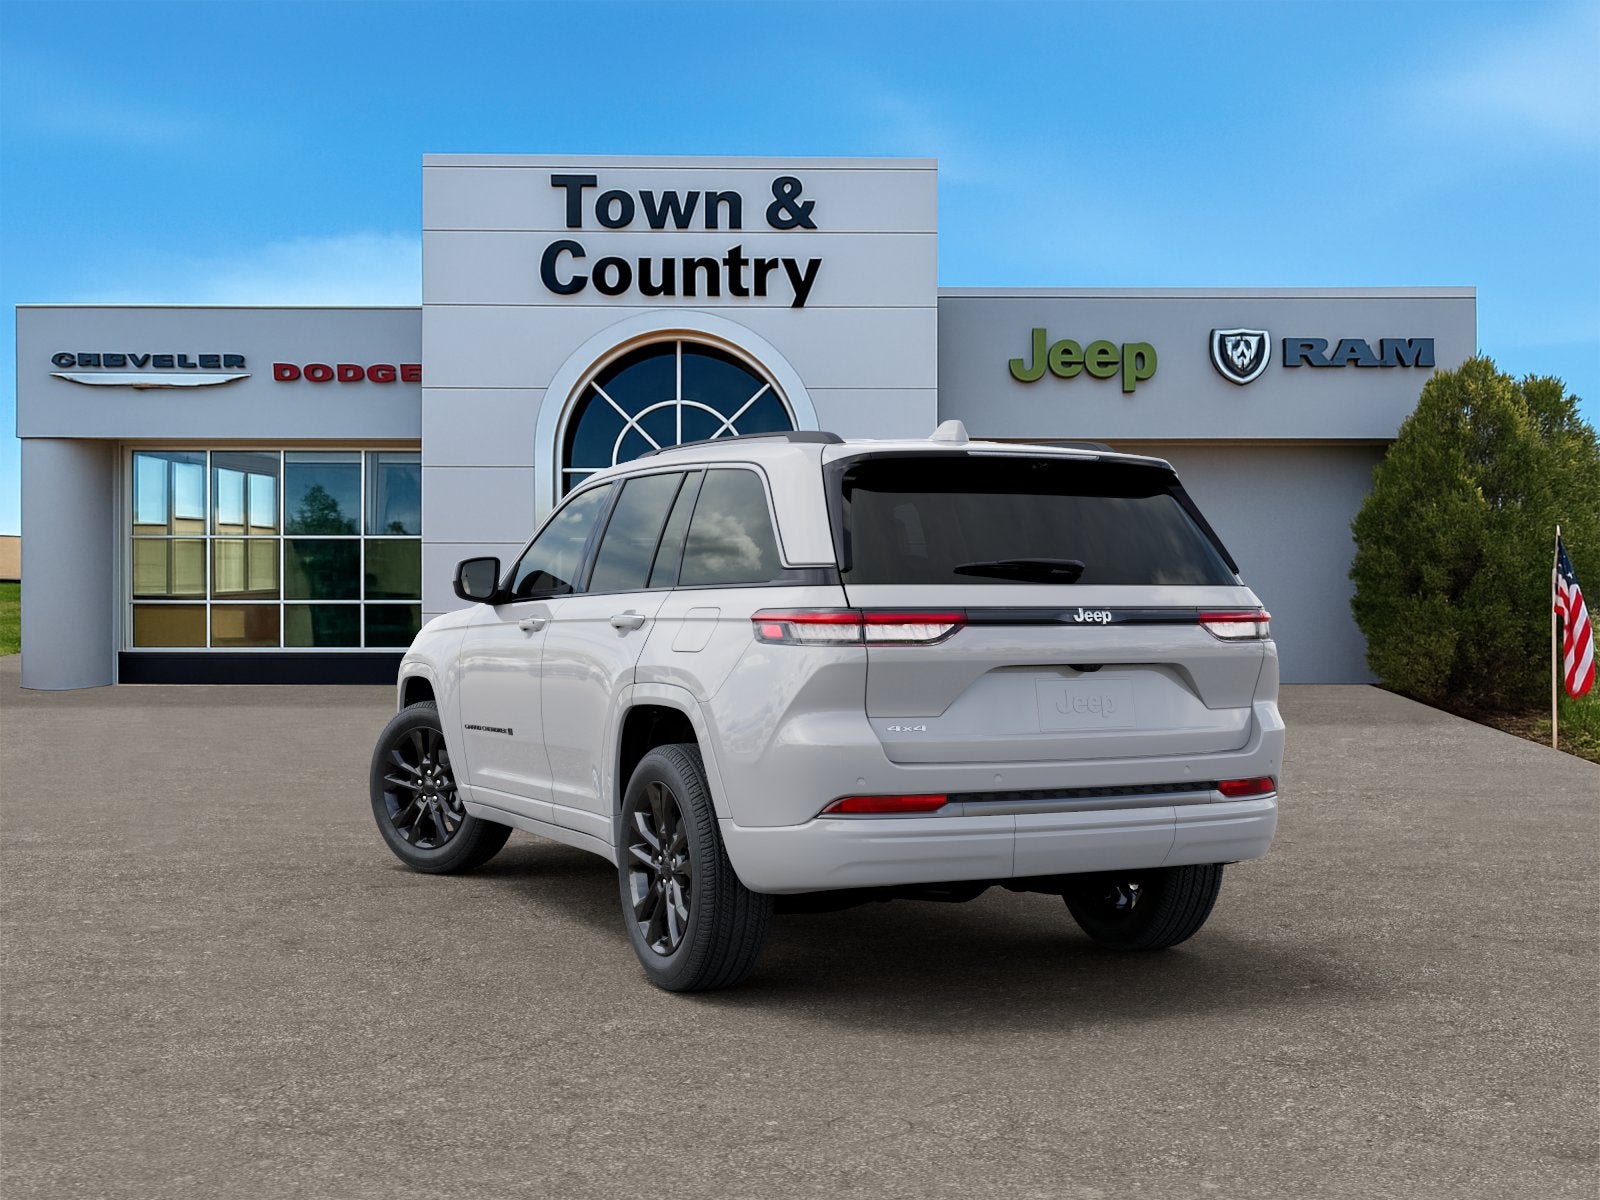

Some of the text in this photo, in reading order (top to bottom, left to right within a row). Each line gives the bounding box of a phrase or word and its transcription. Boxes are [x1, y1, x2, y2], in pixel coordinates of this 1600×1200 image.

[550, 174, 818, 230] Town &
[540, 239, 822, 308] Country
[1009, 328, 1158, 393] Jeep
[1282, 337, 1436, 368] RAM
[273, 362, 422, 383] DODGE
[1073, 607, 1112, 625] Jeep
[1055, 688, 1116, 719] Jeep
